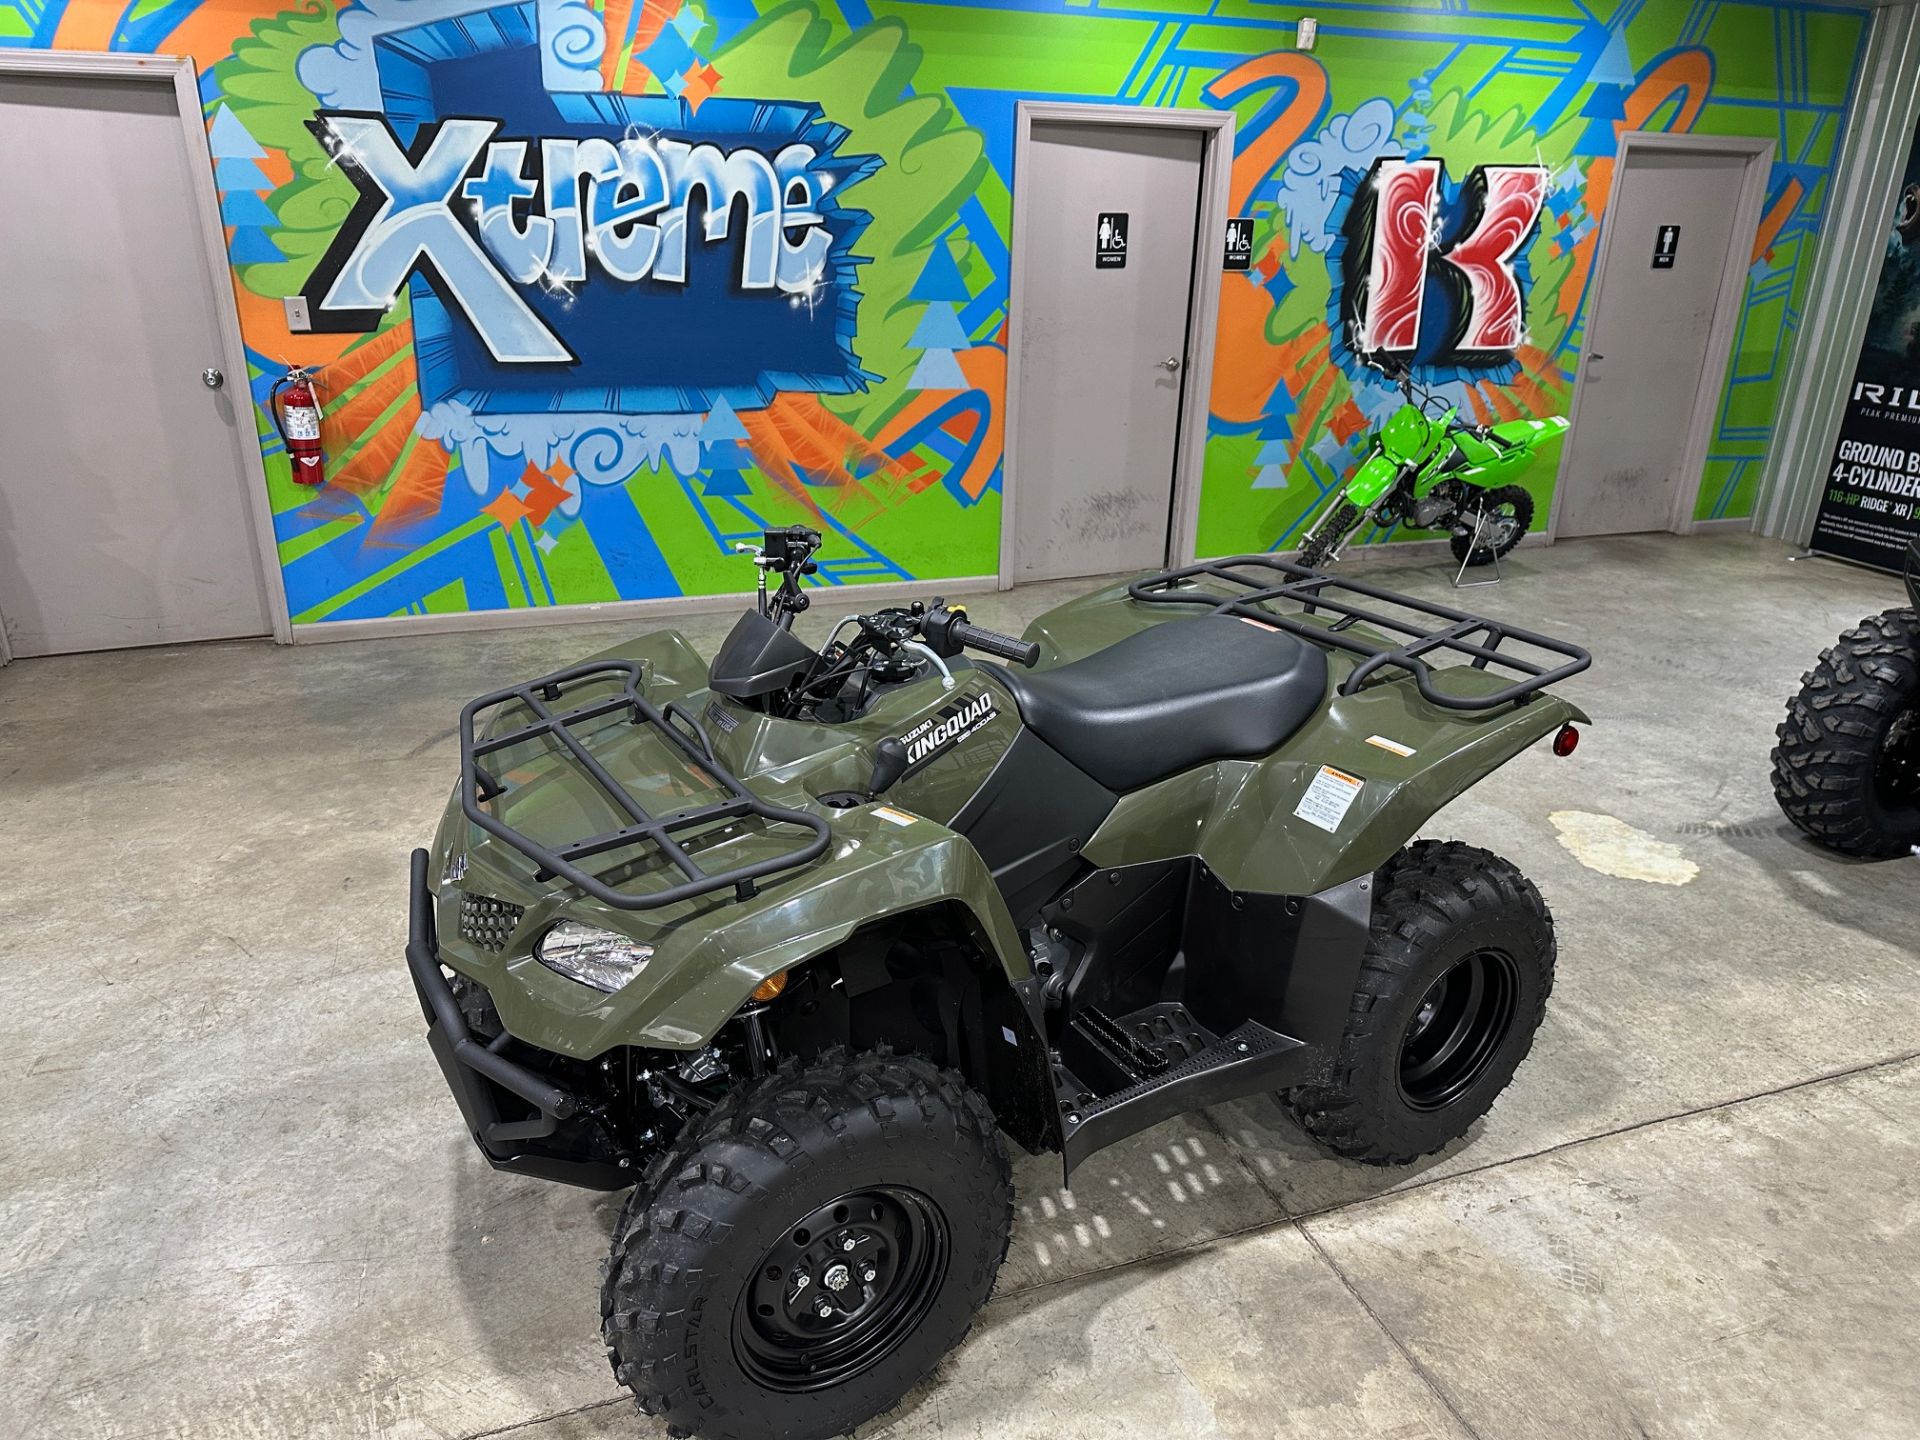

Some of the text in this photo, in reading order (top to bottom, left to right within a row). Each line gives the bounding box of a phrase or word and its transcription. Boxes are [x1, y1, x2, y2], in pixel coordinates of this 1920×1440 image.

[318, 115, 834, 364] Xtreme
[1361, 158, 1548, 353] K
[1838, 439, 1905, 470] GROUND
[1860, 407, 1920, 424] PEAK PREMIU
